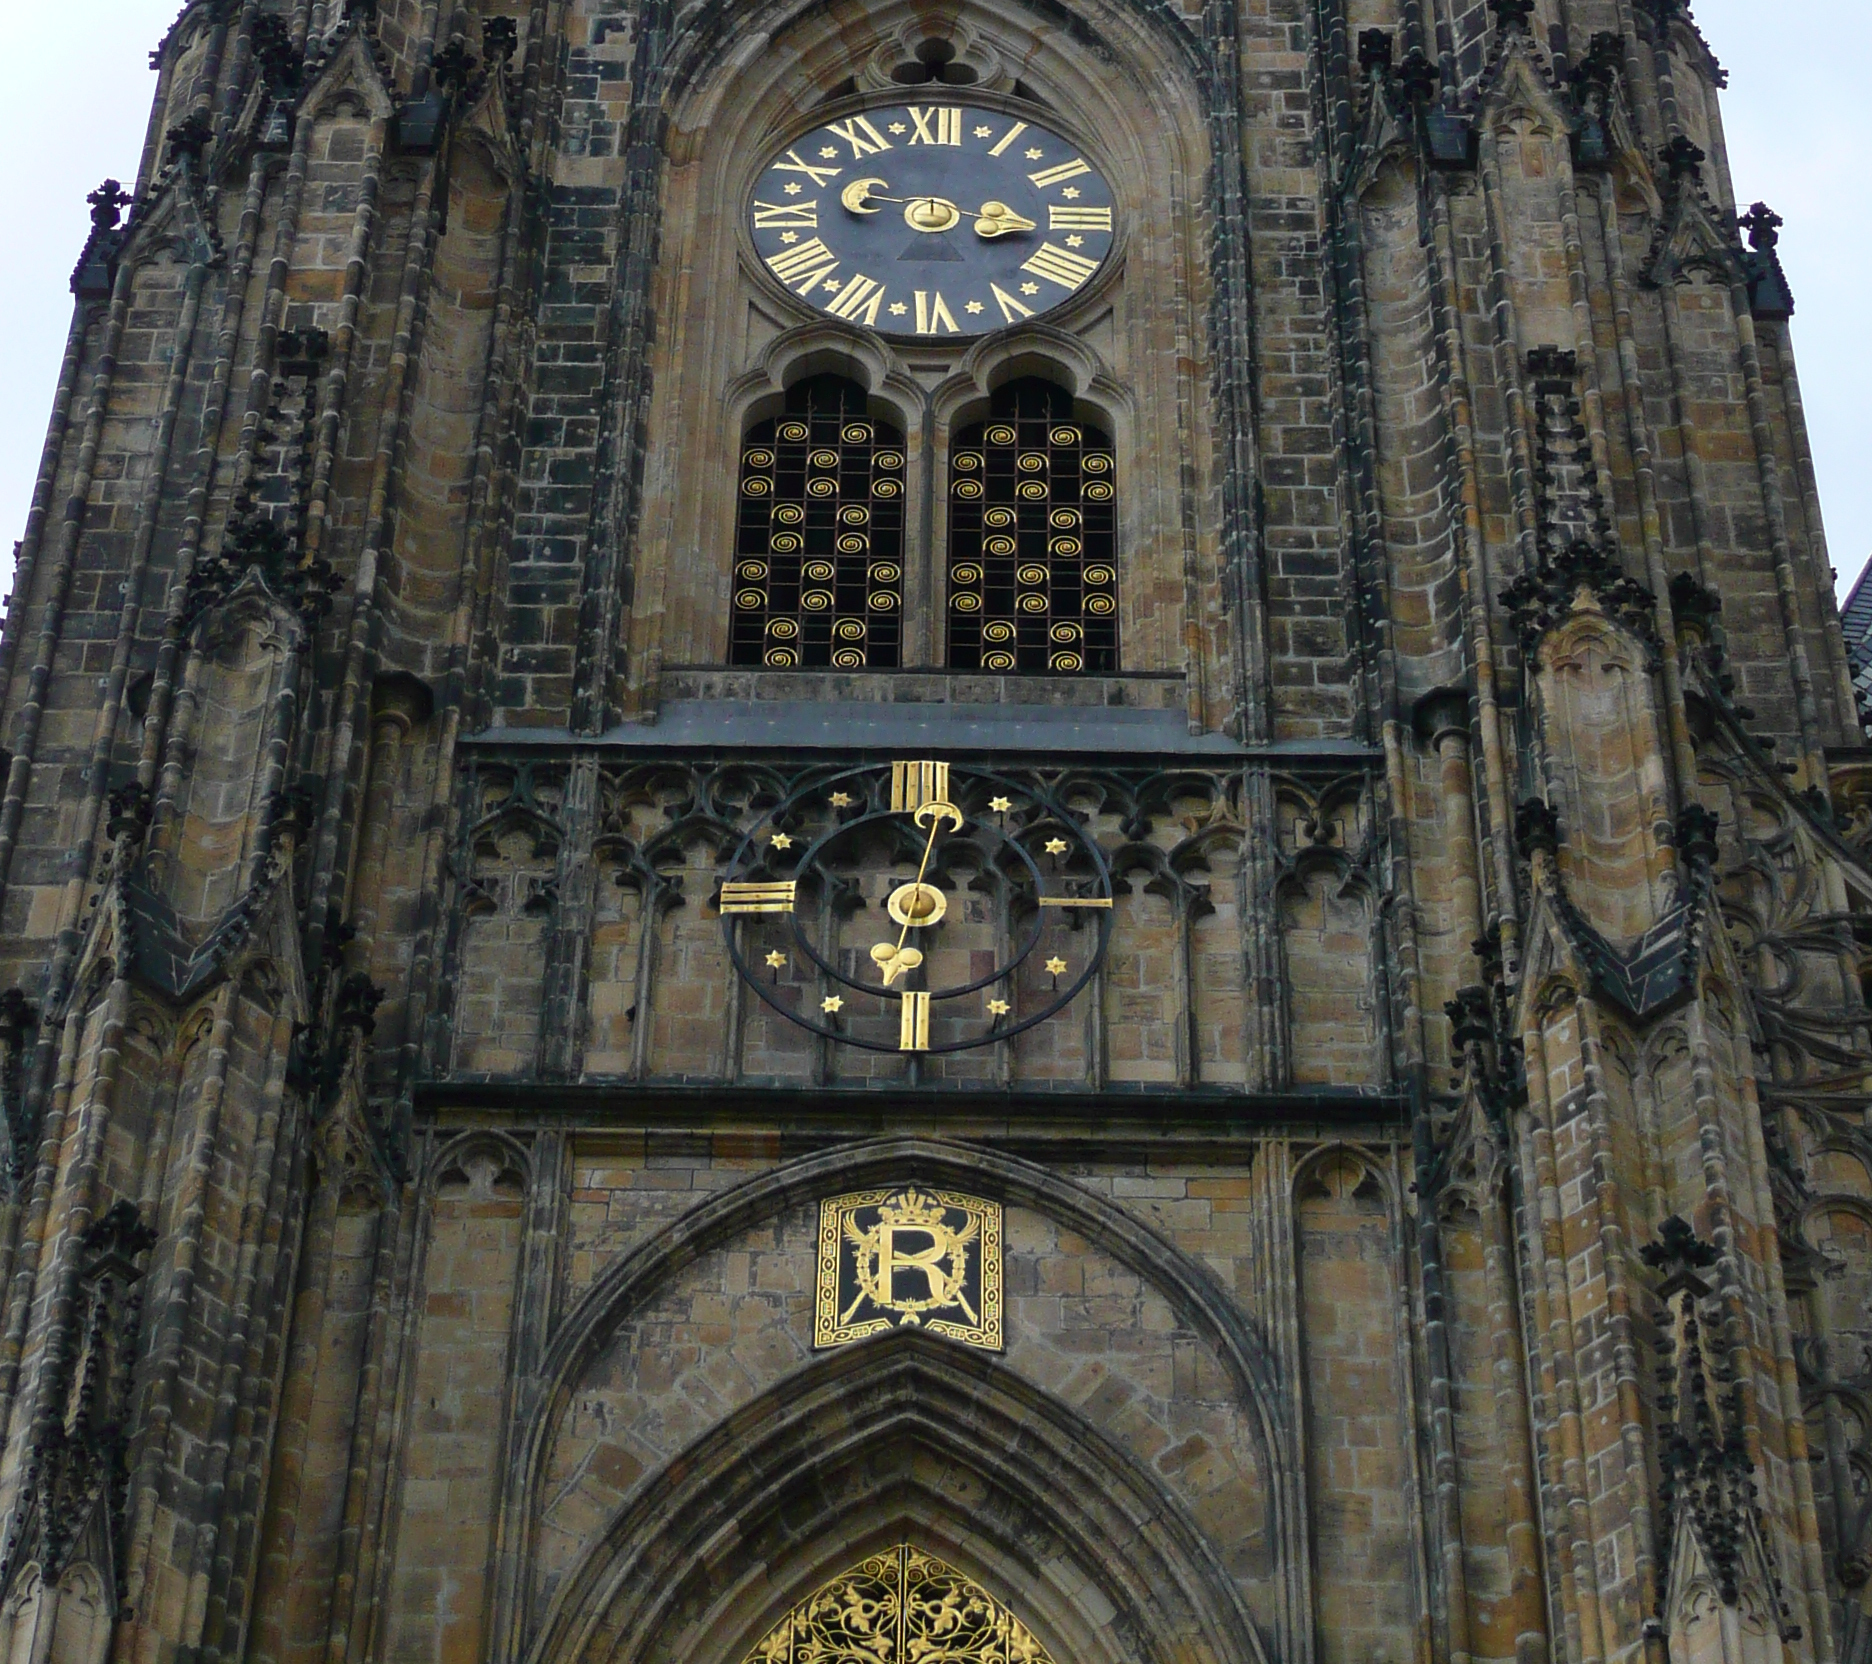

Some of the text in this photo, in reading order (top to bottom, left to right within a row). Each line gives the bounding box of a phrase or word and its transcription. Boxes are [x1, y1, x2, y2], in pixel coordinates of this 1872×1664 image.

[825, 115, 893, 159] XI
[908, 107, 962, 146] XII
[988, 122, 1028, 156] I
[772, 150, 842, 187] X
[1027, 158, 1092, 188] II
[754, 200, 817, 228] IX
[1048, 205, 1112, 232] III
[765, 236, 840, 296] VIII
[1020, 241, 1100, 291] IIII
[824, 273, 886, 326] VII
[914, 290, 961, 334] VI
[990, 282, 1036, 323] V
[720, 881, 797, 915] III
[900, 992, 931, 1050] II
[879, 1225, 959, 1306] R
